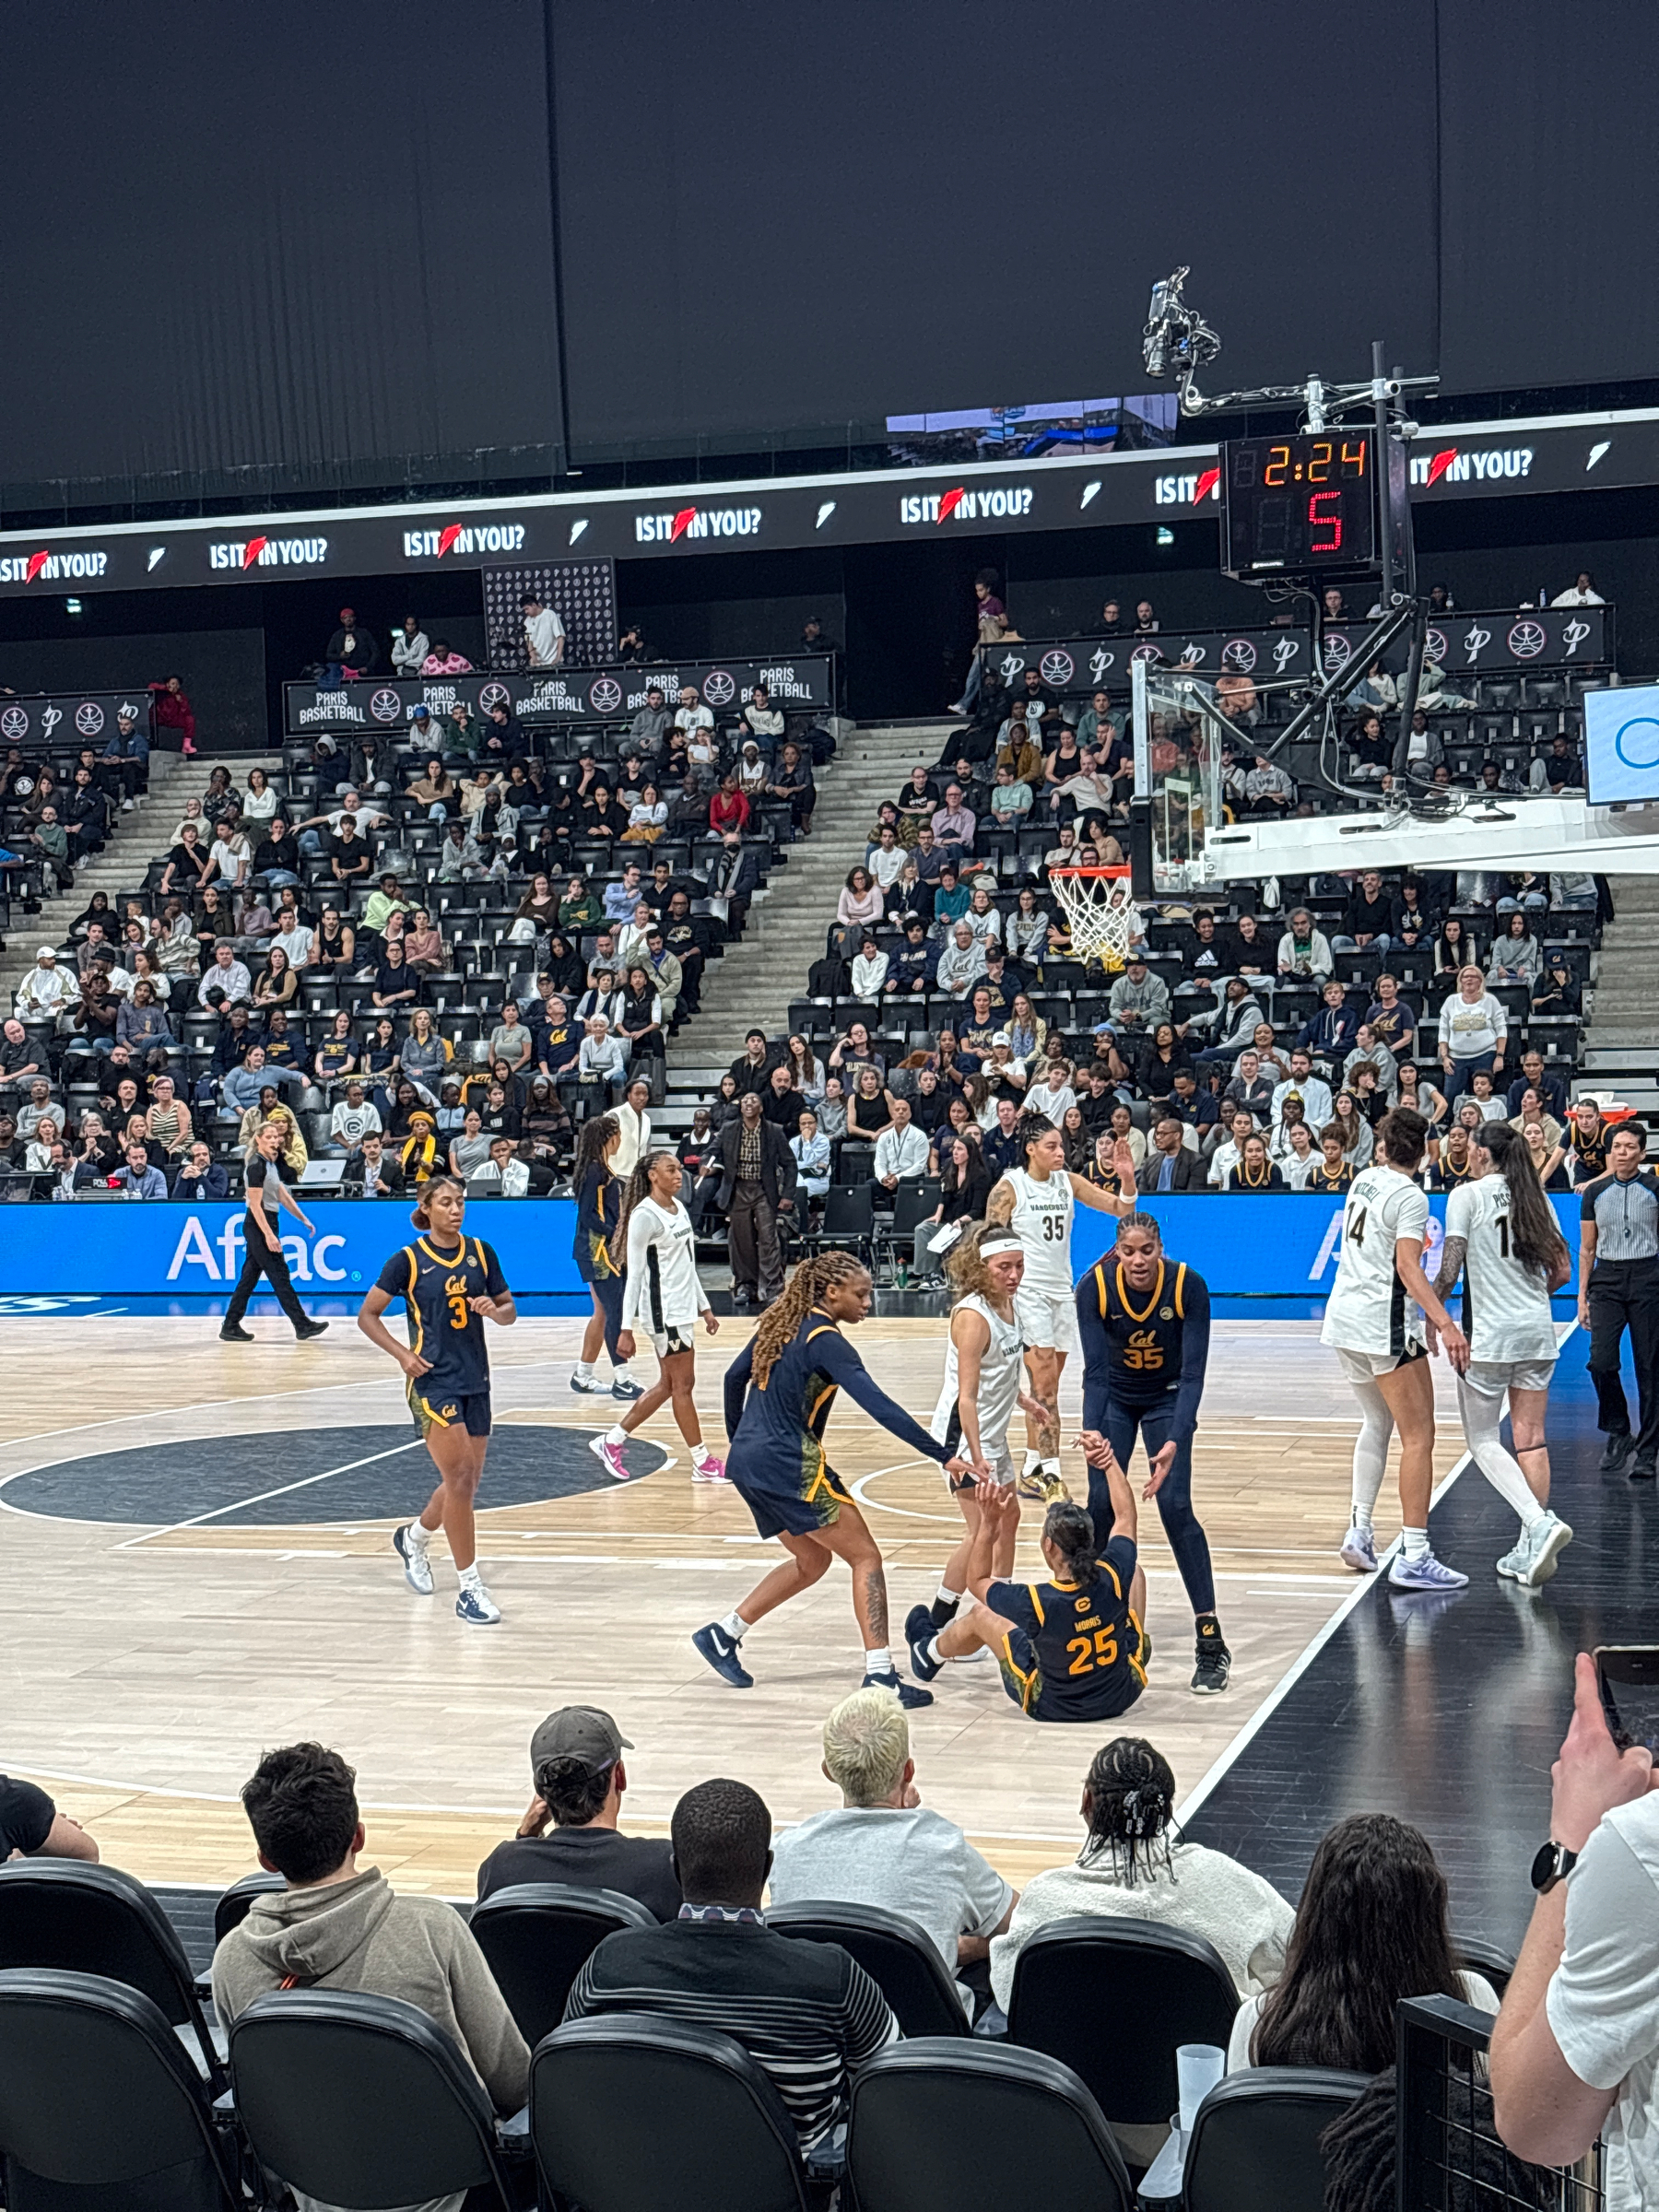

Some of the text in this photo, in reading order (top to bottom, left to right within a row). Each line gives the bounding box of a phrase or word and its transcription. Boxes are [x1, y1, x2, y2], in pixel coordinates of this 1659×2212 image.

[1265, 441, 1366, 487] 2:24
[1471, 450, 1533, 479] YOU?
[977, 488, 1033, 517] YOU?
[708, 509, 761, 536] YOU?
[1309, 491, 1342, 552] 5
[473, 525, 525, 552] YOU?
[277, 538, 327, 564] YOU?
[0, 559, 12, 582] S
[59, 552, 107, 578] YOU?
[645, 675, 678, 690] PARIS
[760, 667, 794, 684] PARIS
[316, 692, 347, 706] PARIS
[423, 687, 456, 702] PARIS
[516, 696, 585, 716] BASKETBALL
[300, 705, 366, 725] BASKETBALL
[549, 1030, 568, 1045] Cal
[1030, 1204, 1069, 1212] VANDERBILT
[1042, 1215, 1065, 1242] 35
[1346, 1201, 1368, 1249] 14
[166, 1212, 347, 1281] Afac
[445, 1276, 467, 1296] Cal
[448, 1296, 468, 1329] 3
[1129, 1330, 1156, 1347] Cal
[1124, 1347, 1163, 1370] 35
[442, 1404, 458, 1418] Cal
[1074, 1615, 1101, 1632] MORRIS
[1066, 1623, 1118, 1676] 25
